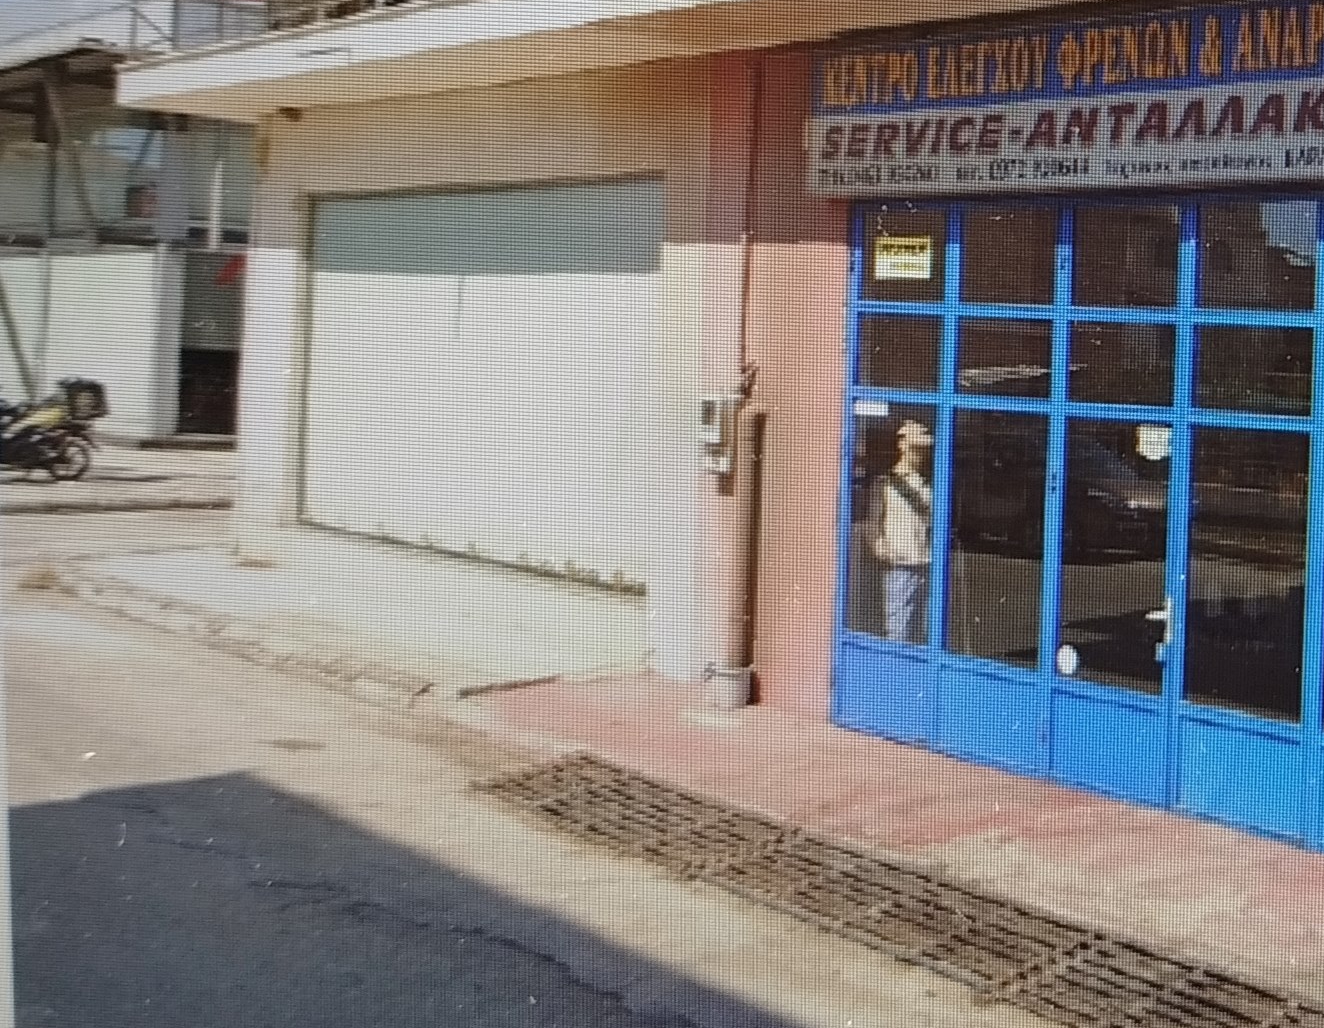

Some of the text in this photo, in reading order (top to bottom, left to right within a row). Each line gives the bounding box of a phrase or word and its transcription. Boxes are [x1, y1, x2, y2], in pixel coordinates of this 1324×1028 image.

[823, 51, 920, 108] ΚΕΝΤΡΟ
[927, 36, 1048, 99] ΕΛΕΓΧΟΥ
[1058, 20, 1189, 89] ΦΡΕΝΩΝ
[1201, 17, 1222, 78] &
